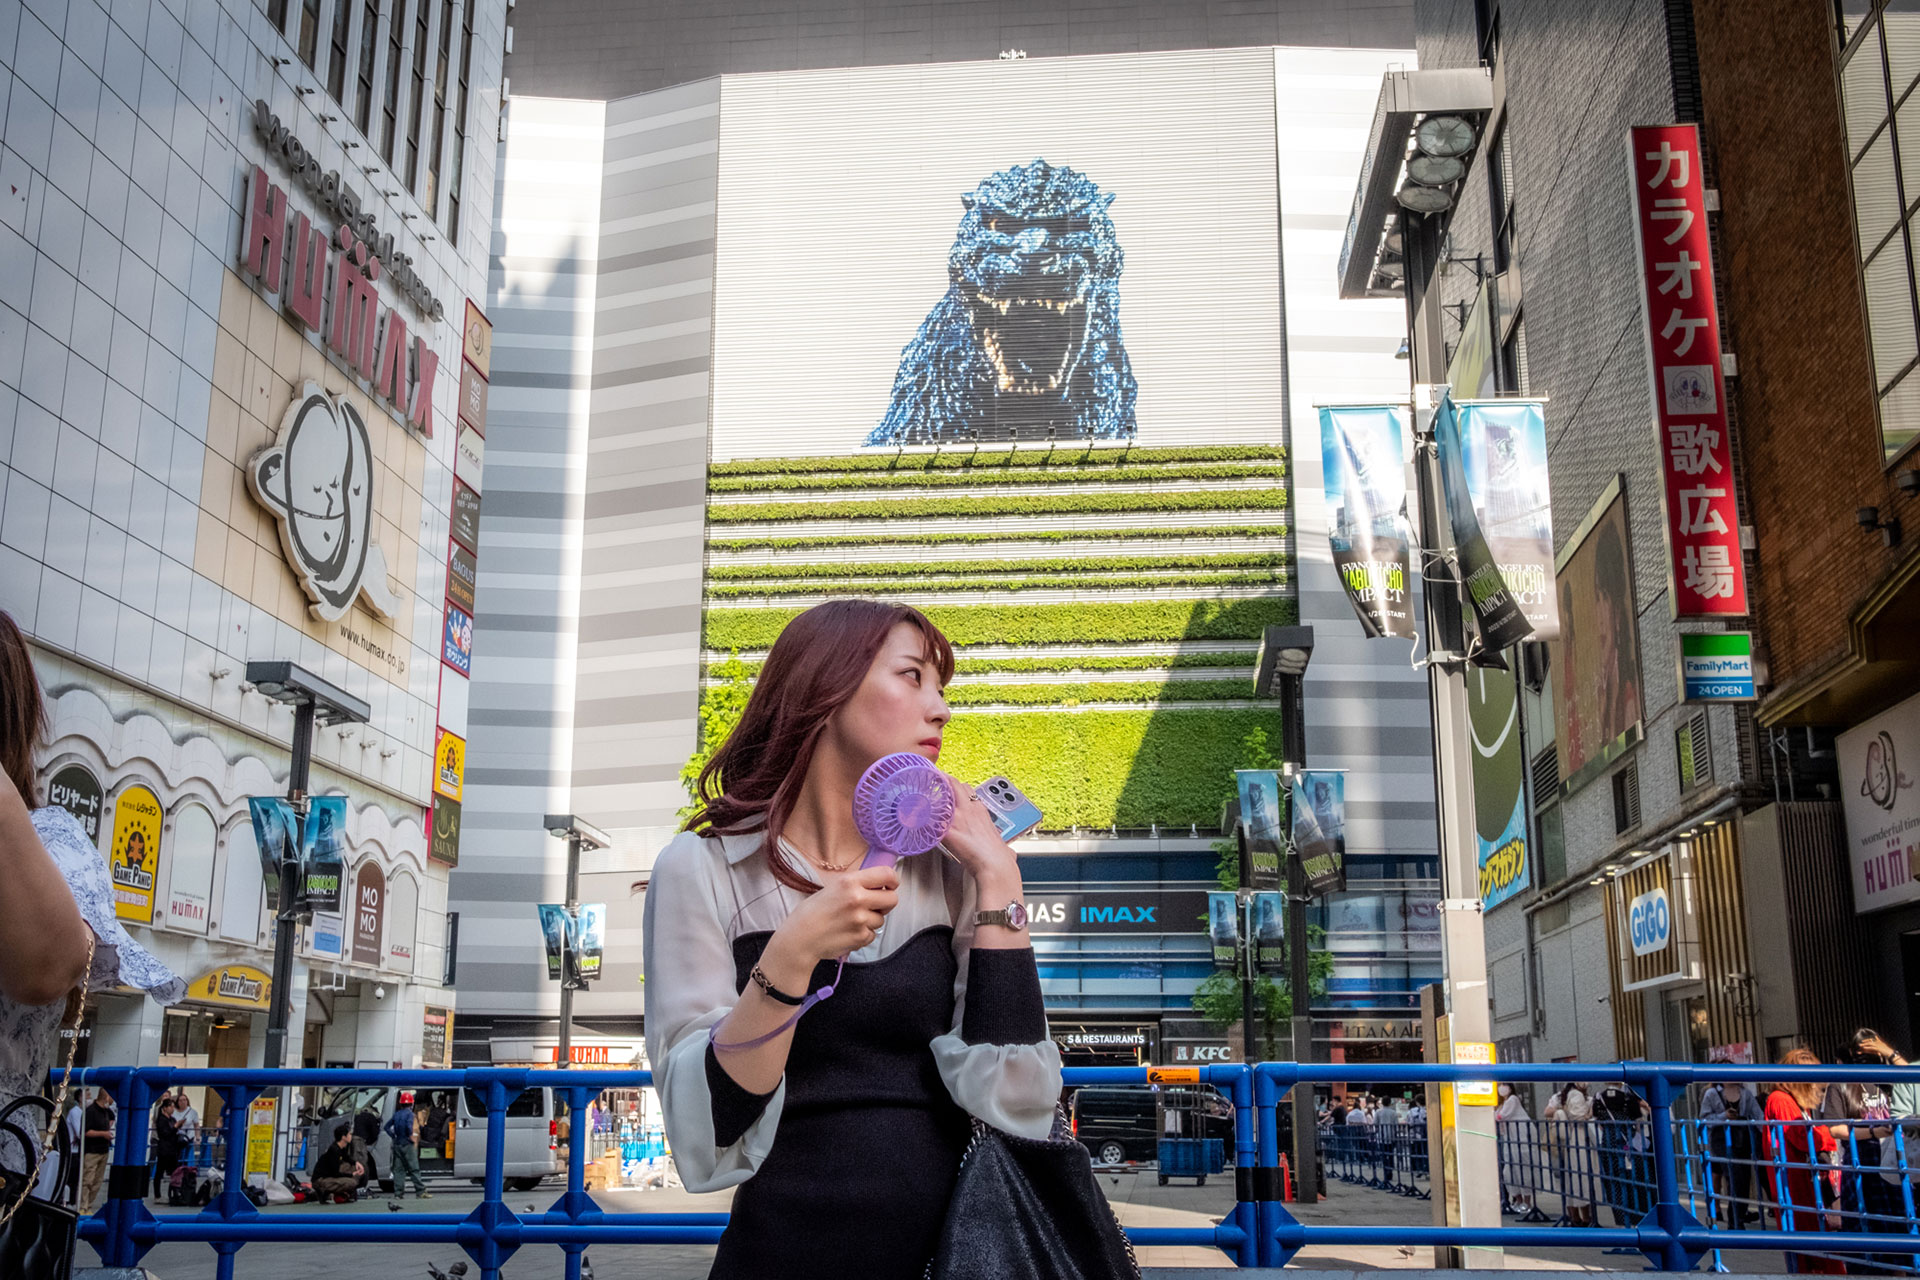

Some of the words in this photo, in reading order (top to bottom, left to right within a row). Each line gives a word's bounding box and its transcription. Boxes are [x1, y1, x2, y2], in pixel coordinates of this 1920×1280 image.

[256, 99, 395, 270] wonderful
[393, 251, 445, 322] time
[1645, 141, 1709, 358] カラオケ
[241, 164, 440, 440] HUMAX
[1668, 422, 1735, 599] 歌広場
[453, 557, 474, 584] BAGUS
[340, 624, 405, 675] www.humax.co.jp
[446, 647, 468, 670] ボウリング
[1686, 660, 1749, 673] FamilyMart
[1698, 686, 1711, 695] 24
[1711, 685, 1743, 695] OPEN
[51, 783, 99, 813] ビリヤード
[1861, 820, 1904, 847] wonderful
[434, 838, 457, 858] SAUNA
[113, 861, 132, 882] GAME
[132, 867, 152, 888] PANIC
[361, 885, 378, 907] MO
[172, 898, 205, 920] HUMAX
[1080, 906, 1157, 923] IMAX
[360, 912, 377, 933] MO
[219, 972, 238, 994] GAME
[237, 975, 256, 996] PANIC
[1074, 1034, 1082, 1044] &
[1082, 1034, 1145, 1044] RESTAURANTS
[1192, 1046, 1231, 1060] KFC
